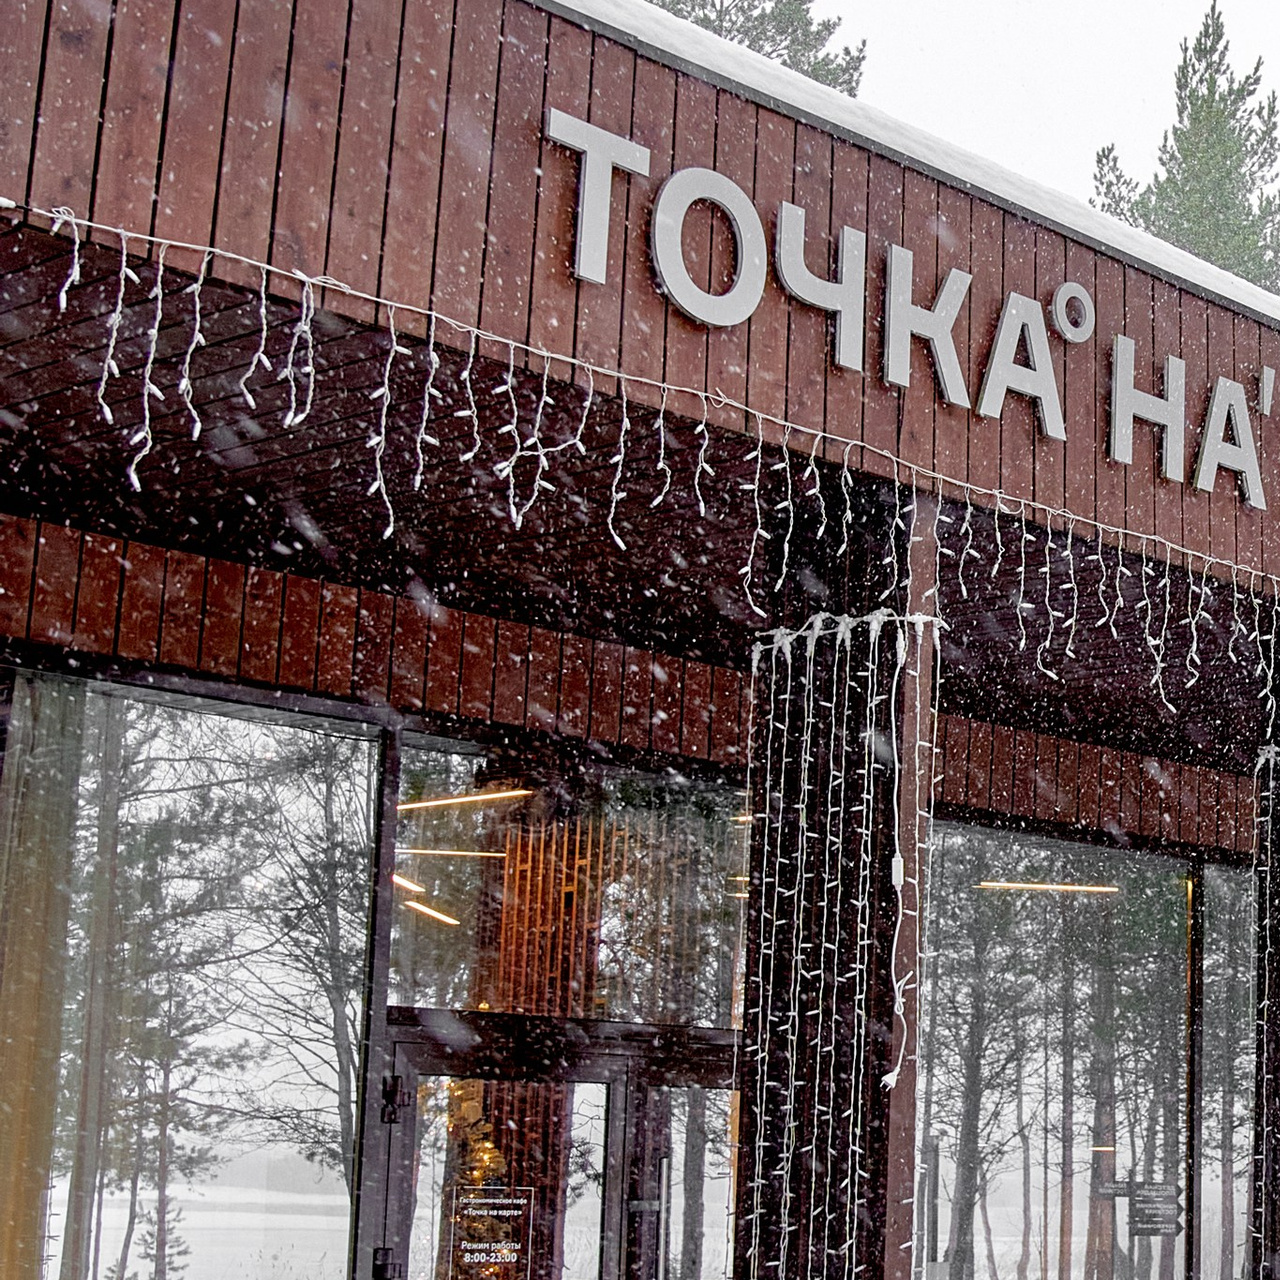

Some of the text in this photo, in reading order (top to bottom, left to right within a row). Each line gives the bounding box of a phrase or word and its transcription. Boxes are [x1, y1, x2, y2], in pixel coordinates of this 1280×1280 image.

[463, 1208, 488, 1216] «Точка
[461, 1240, 521, 1251] Режим работы
[464, 1252, 517, 1263] 8:00-23:00
